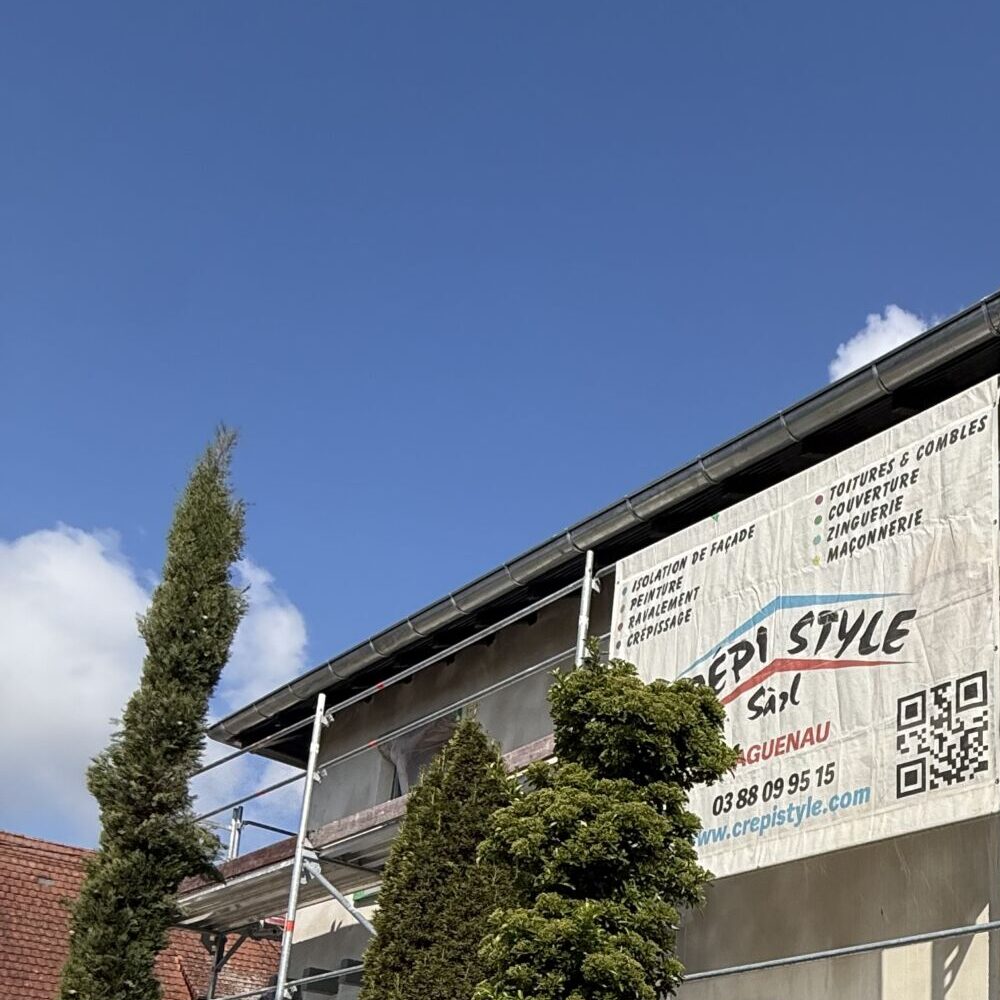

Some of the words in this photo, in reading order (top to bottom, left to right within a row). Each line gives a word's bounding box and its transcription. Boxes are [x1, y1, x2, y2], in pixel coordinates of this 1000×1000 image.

[829, 458, 896, 501] TOITURES
[899, 451, 910, 468] &
[916, 414, 988, 462] COMBLES
[826, 495, 904, 542] ZINGUERIE
[828, 468, 920, 521] COUVERTURE
[631, 556, 688, 593] ISOLATION
[691, 547, 707, 565] DE
[710, 524, 756, 556] FAÇADE
[826, 508, 924, 564] MAÇONNERIE
[627, 586, 701, 630] RAVALEMENT
[629, 576, 683, 611] PEINTURE
[787, 609, 917, 659] STYLE
[735, 720, 831, 767] AGUENAU
[712, 791, 734, 816] 03
[735, 784, 759, 810] 88
[762, 777, 785, 803] 09
[787, 769, 811, 796] 95
[815, 762, 836, 787] 15
[696, 785, 872, 847] ww.crepistyle.com
